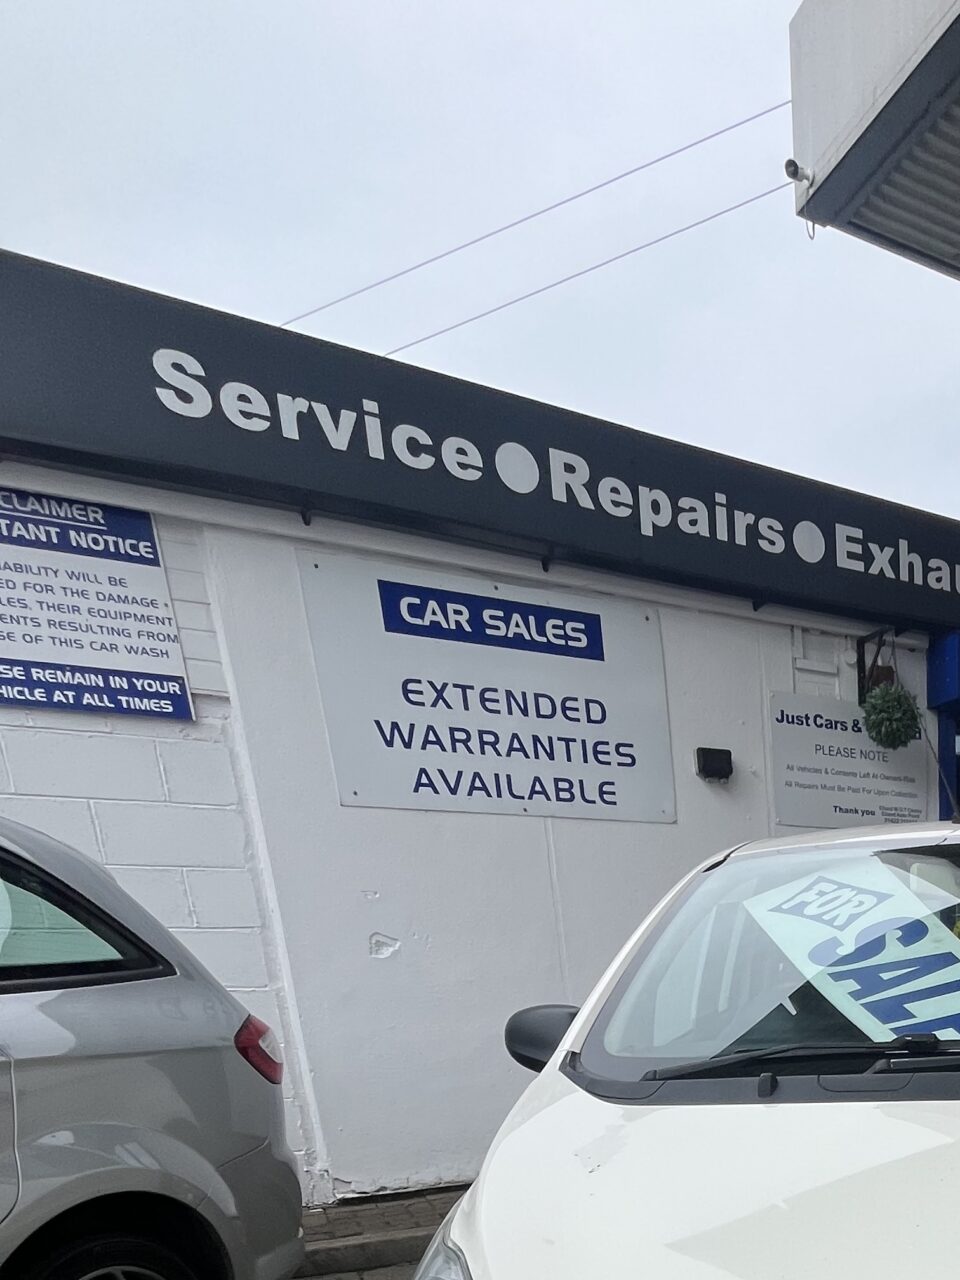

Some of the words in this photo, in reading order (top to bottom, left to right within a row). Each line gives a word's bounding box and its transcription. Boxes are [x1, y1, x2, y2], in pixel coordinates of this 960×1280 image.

[152, 348, 484, 481] Service
[548, 446, 786, 555] Repairs
[69, 530, 155, 558] NOTICE
[65, 569, 103, 585] WILL
[108, 576, 128, 588] BE
[23, 581, 56, 595] FOR
[60, 586, 90, 599] THE
[95, 591, 160, 608] DAMAGE
[33, 600, 81, 616] THEIR
[87, 607, 174, 627] EQUIPMENT
[399, 596, 471, 633] CAR
[484, 609, 589, 649] SALES
[47, 618, 132, 638] RESULTING
[137, 630, 180, 644] FROM
[22, 633, 44, 645] OF
[49, 636, 85, 649] THIS
[89, 640, 119, 653] CAR
[124, 644, 170, 659] WASH
[30, 667, 105, 688] REMAIN
[109, 675, 129, 690] IN
[132, 678, 182, 695] YOUR
[52, 690, 76, 704] AT
[82, 692, 116, 708] ALL
[117, 695, 174, 713] TIMES
[402, 678, 609, 726] EXTENDED
[775, 709, 811, 727] Just
[813, 713, 848, 732] Cars
[851, 718, 863, 733] &
[374, 719, 638, 768] WARRANTIES
[815, 743, 857, 759] PLEASE
[860, 749, 889, 763] NOTE
[413, 767, 618, 807] AVAILABLE
[833, 805, 859, 815] Thank
[860, 807, 875, 817] you
[781, 881, 877, 927] FOR
